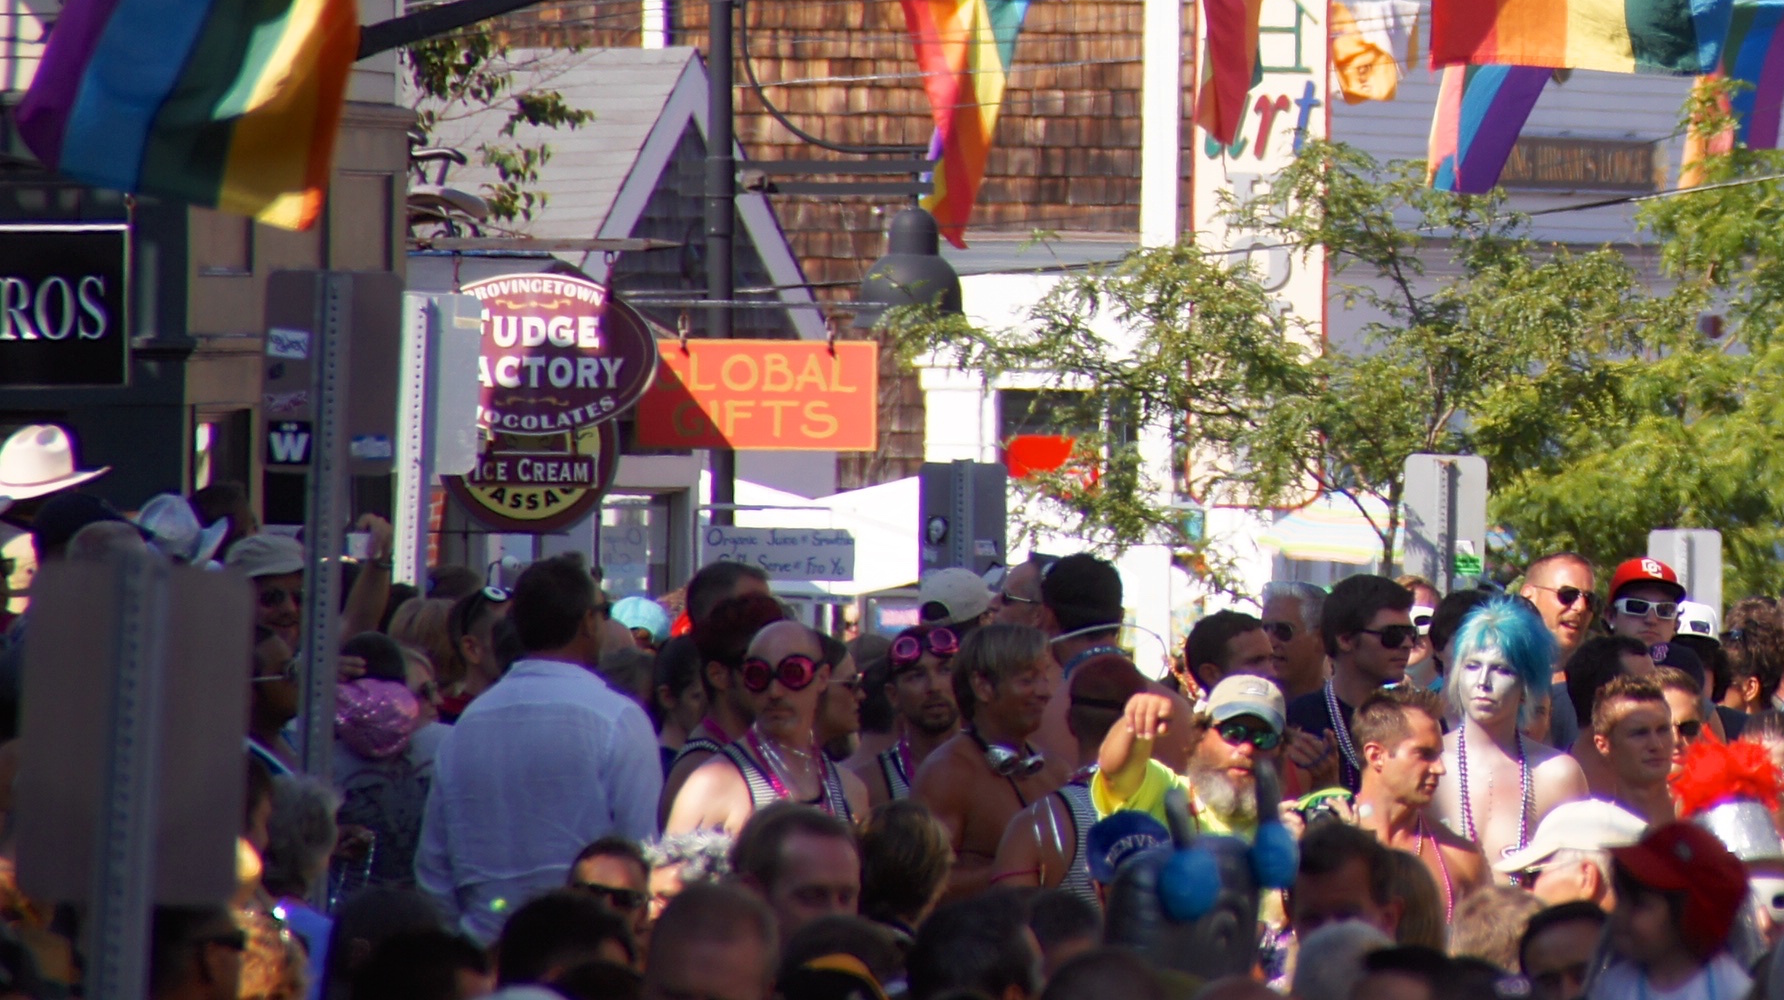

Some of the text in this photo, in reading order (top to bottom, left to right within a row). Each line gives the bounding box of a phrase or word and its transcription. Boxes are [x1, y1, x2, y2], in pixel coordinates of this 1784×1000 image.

[1204, 81, 1321, 161] rt
[0, 275, 107, 341] ROS
[655, 352, 858, 394] GLOBAL
[671, 399, 839, 440] GIFTS
[517, 457, 588, 482] CREAM
[478, 486, 576, 510] ASSA
